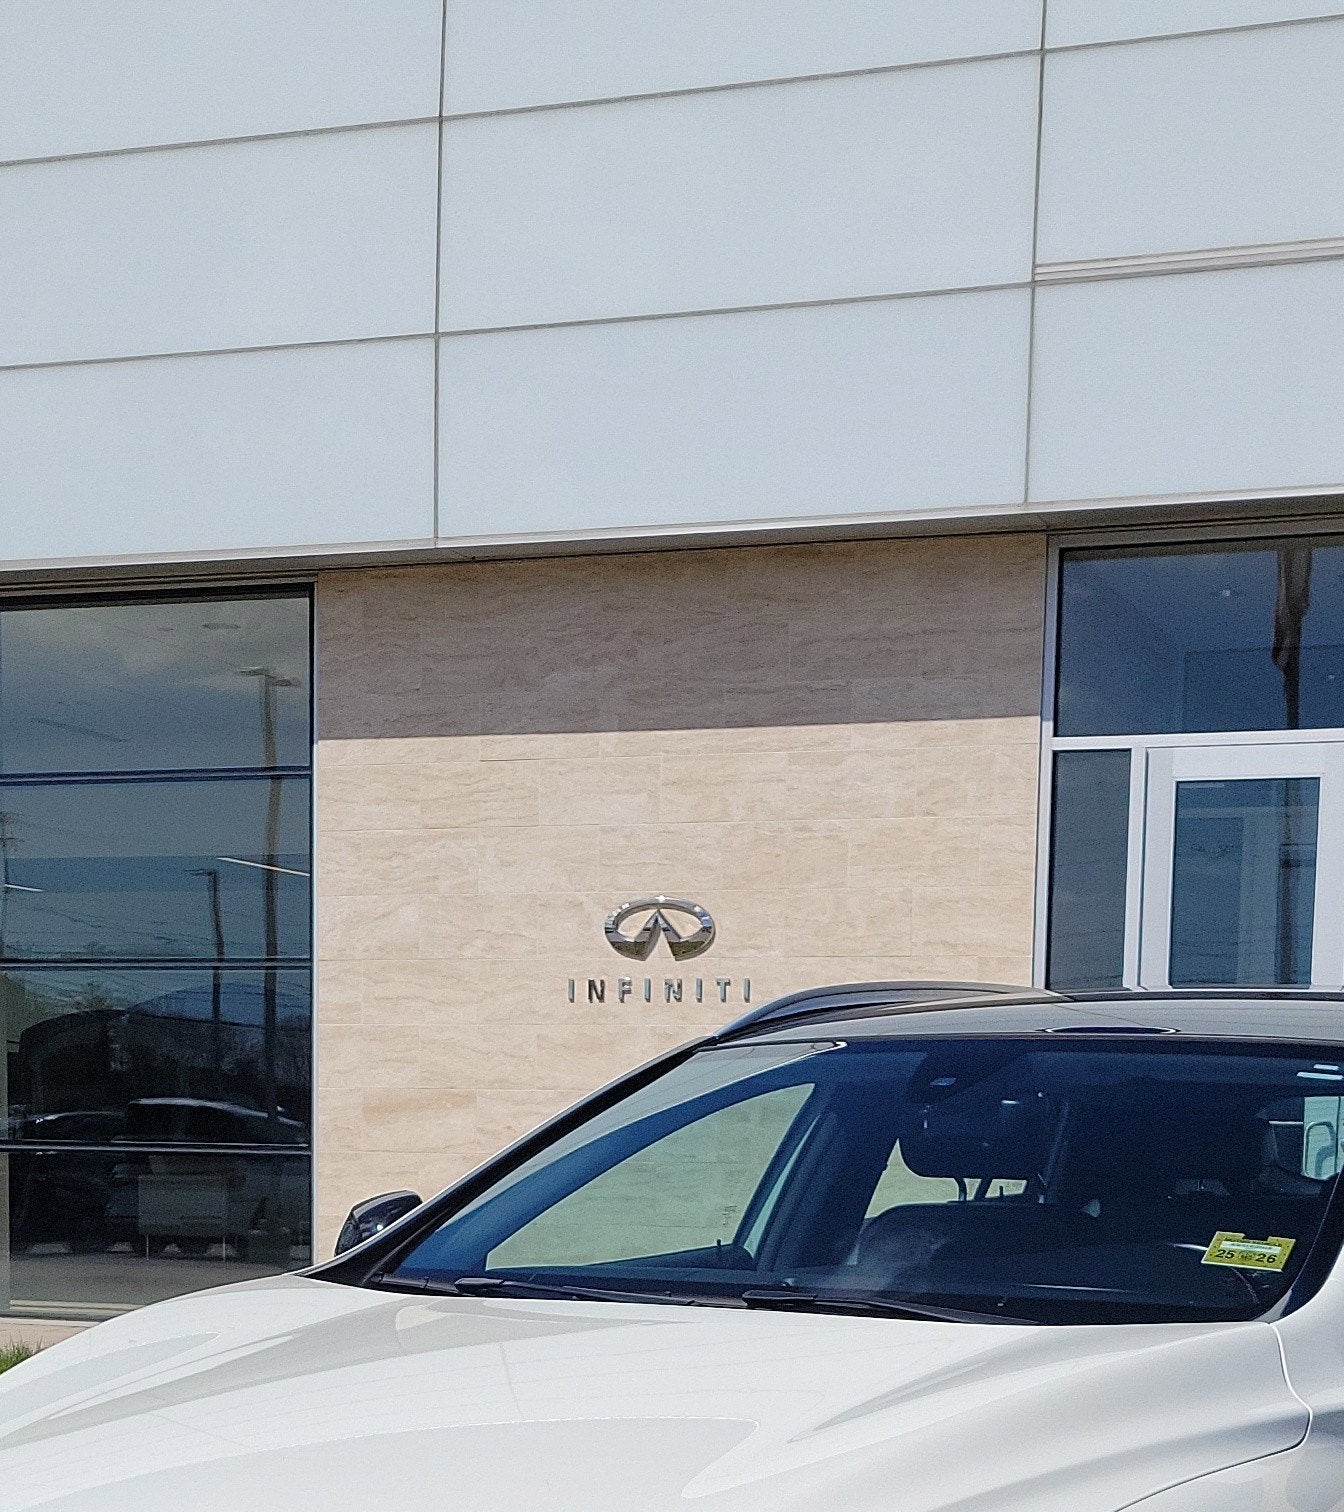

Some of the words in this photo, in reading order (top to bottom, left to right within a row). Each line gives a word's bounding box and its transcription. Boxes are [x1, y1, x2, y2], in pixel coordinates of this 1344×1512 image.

[567, 977, 751, 1004] INFINITI
[1215, 1249, 1235, 1259] 25
[1255, 1253, 1278, 1263] 26
